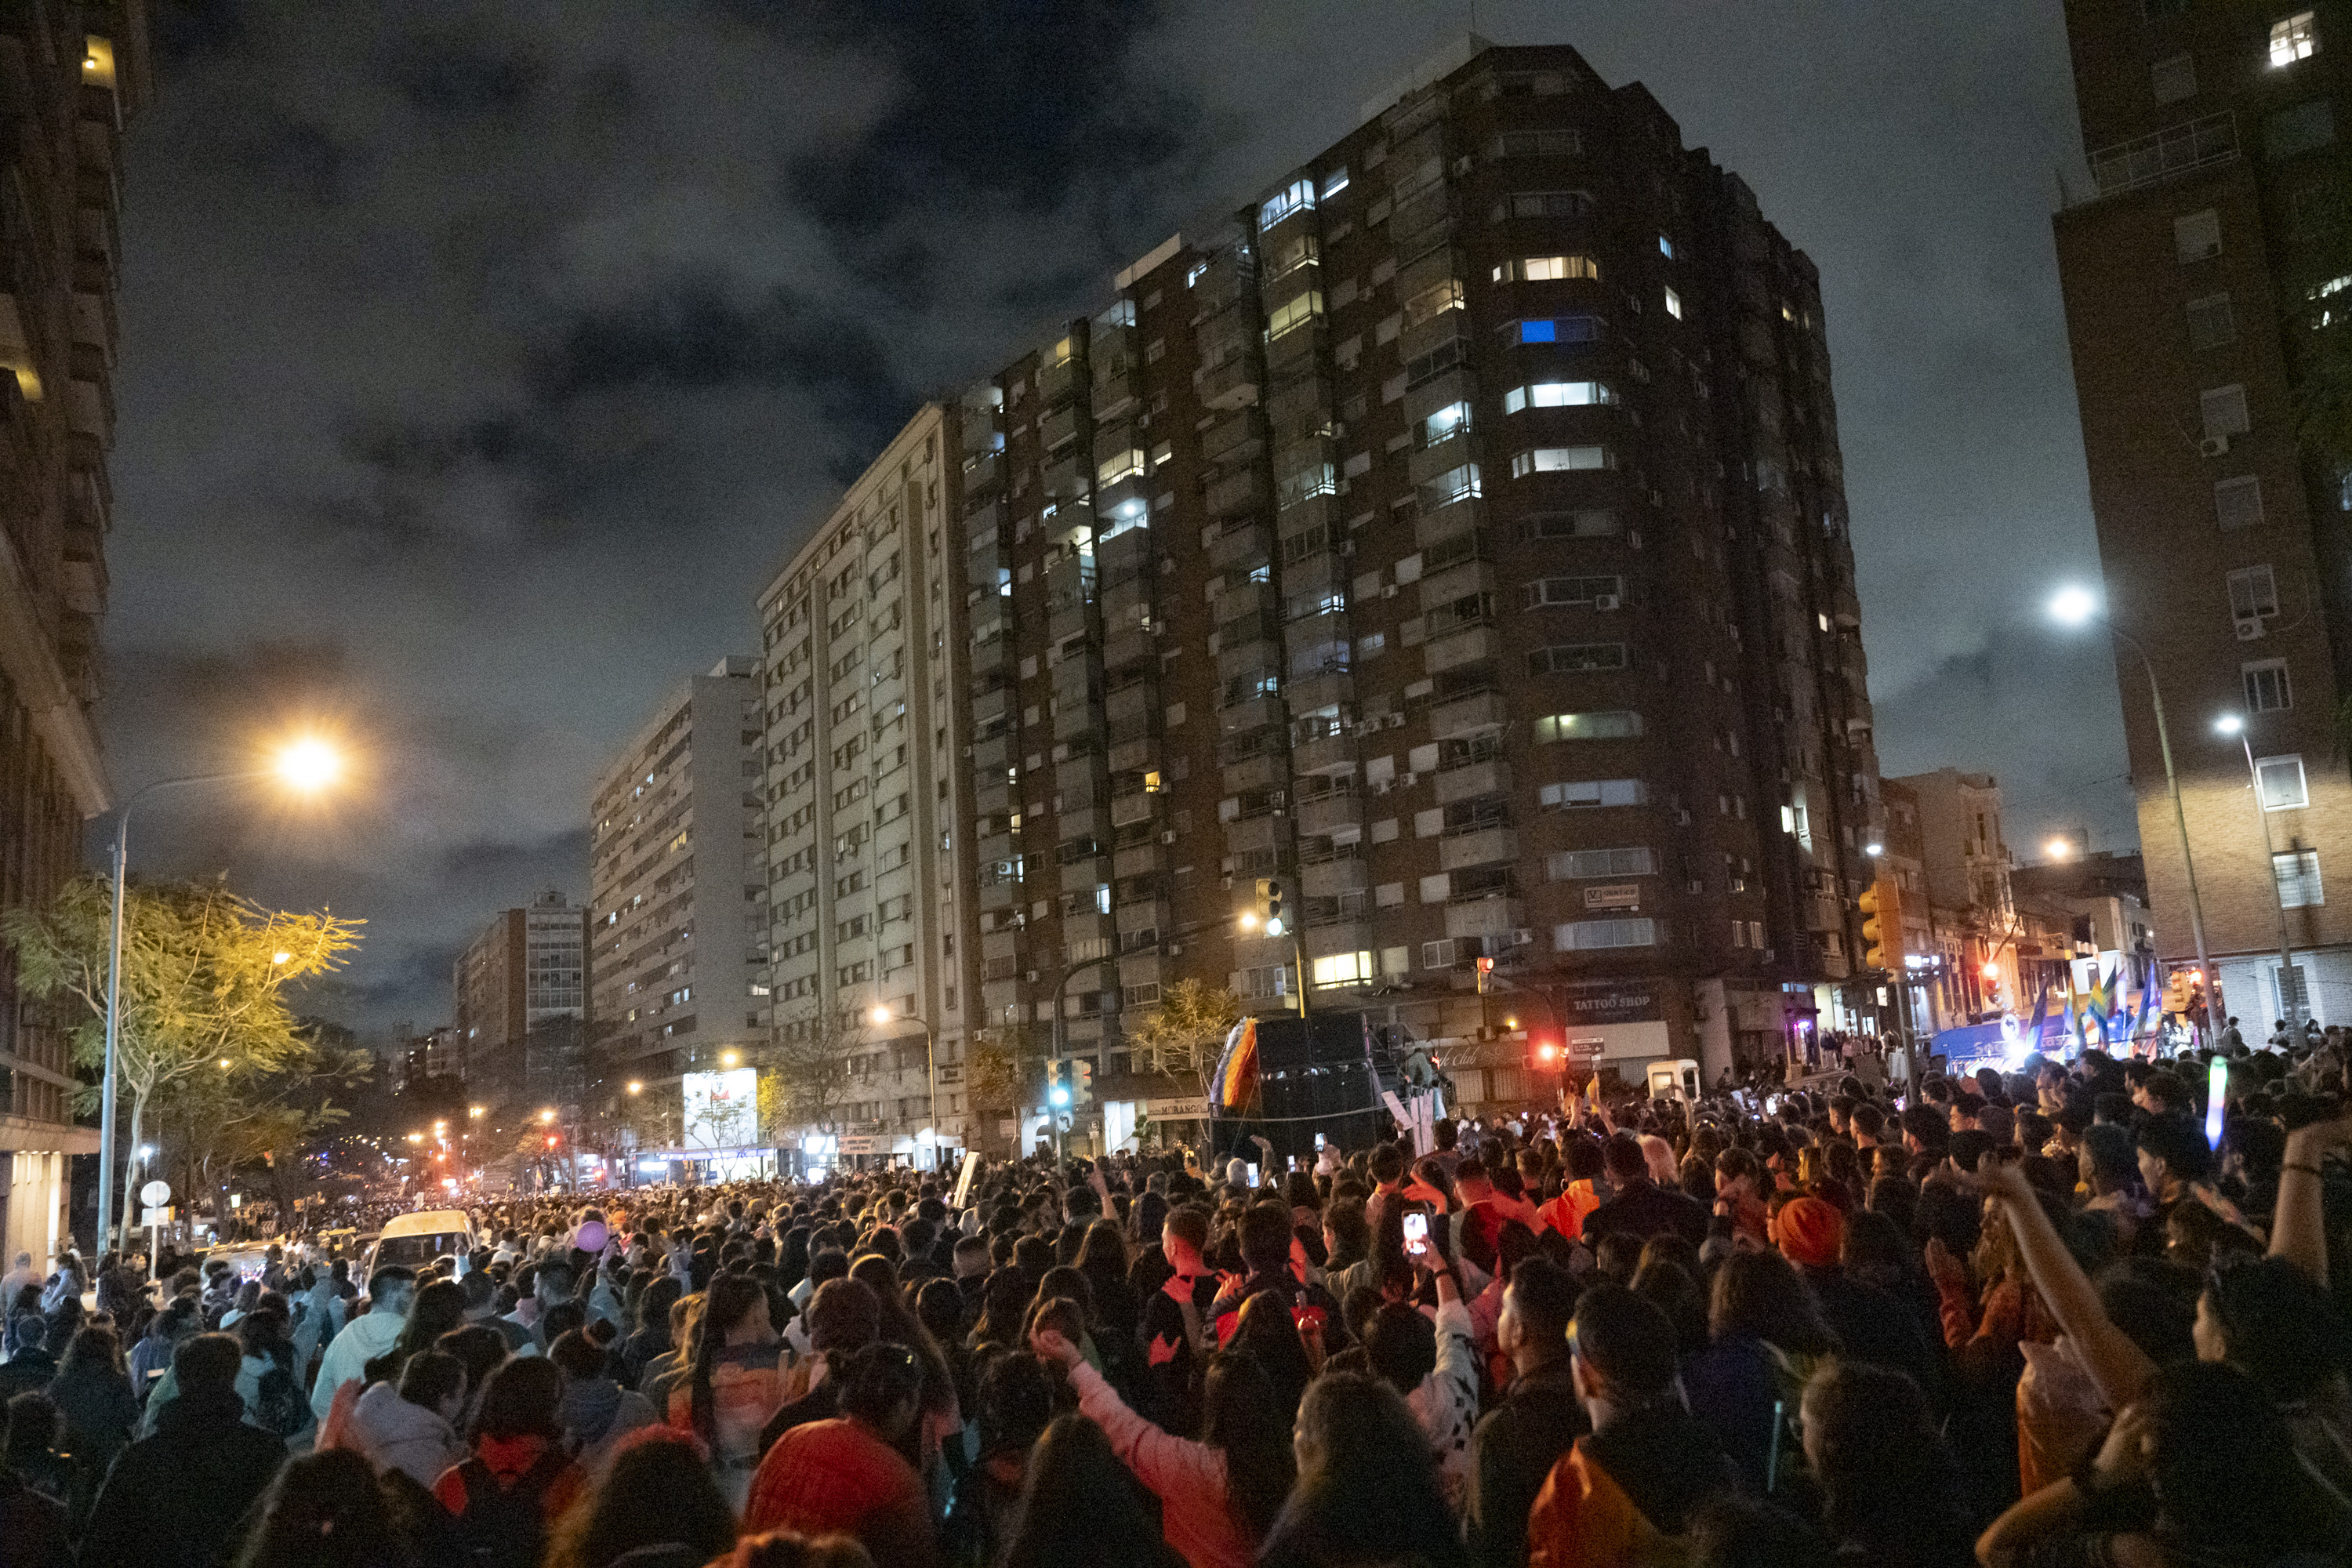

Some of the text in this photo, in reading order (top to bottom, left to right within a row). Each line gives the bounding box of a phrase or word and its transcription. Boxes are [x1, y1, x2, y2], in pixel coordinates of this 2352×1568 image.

[1574, 996, 1650, 1010] TATTOO SHOP
[1161, 1104, 1202, 1115] MORANGO
